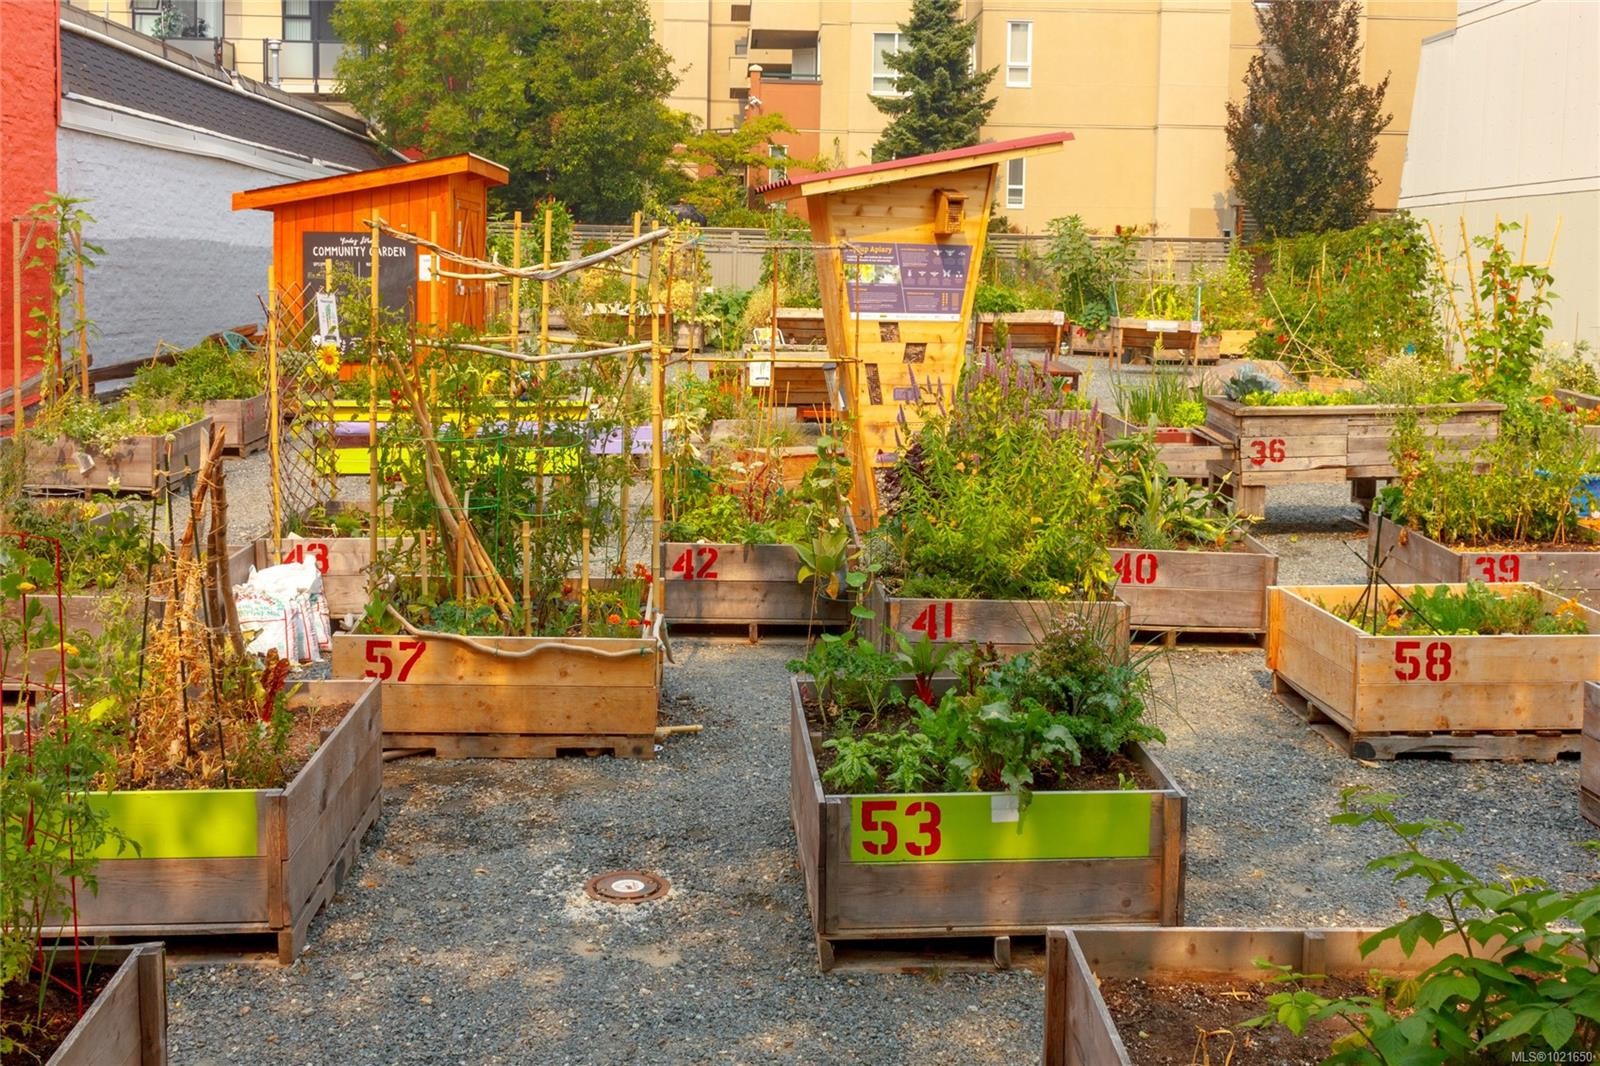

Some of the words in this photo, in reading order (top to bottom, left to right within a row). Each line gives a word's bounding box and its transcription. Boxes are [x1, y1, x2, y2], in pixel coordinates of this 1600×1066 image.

[312, 246, 366, 257] COMMUNITY
[1250, 438, 1286, 466] 36
[282, 543, 329, 574] 43
[671, 547, 719, 580] 42
[1113, 552, 1158, 584] 40
[1474, 553, 1520, 583] 39
[911, 602, 953, 640] 41
[364, 639, 427, 682] 57
[1394, 640, 1453, 682] 58
[861, 800, 942, 857] 53
